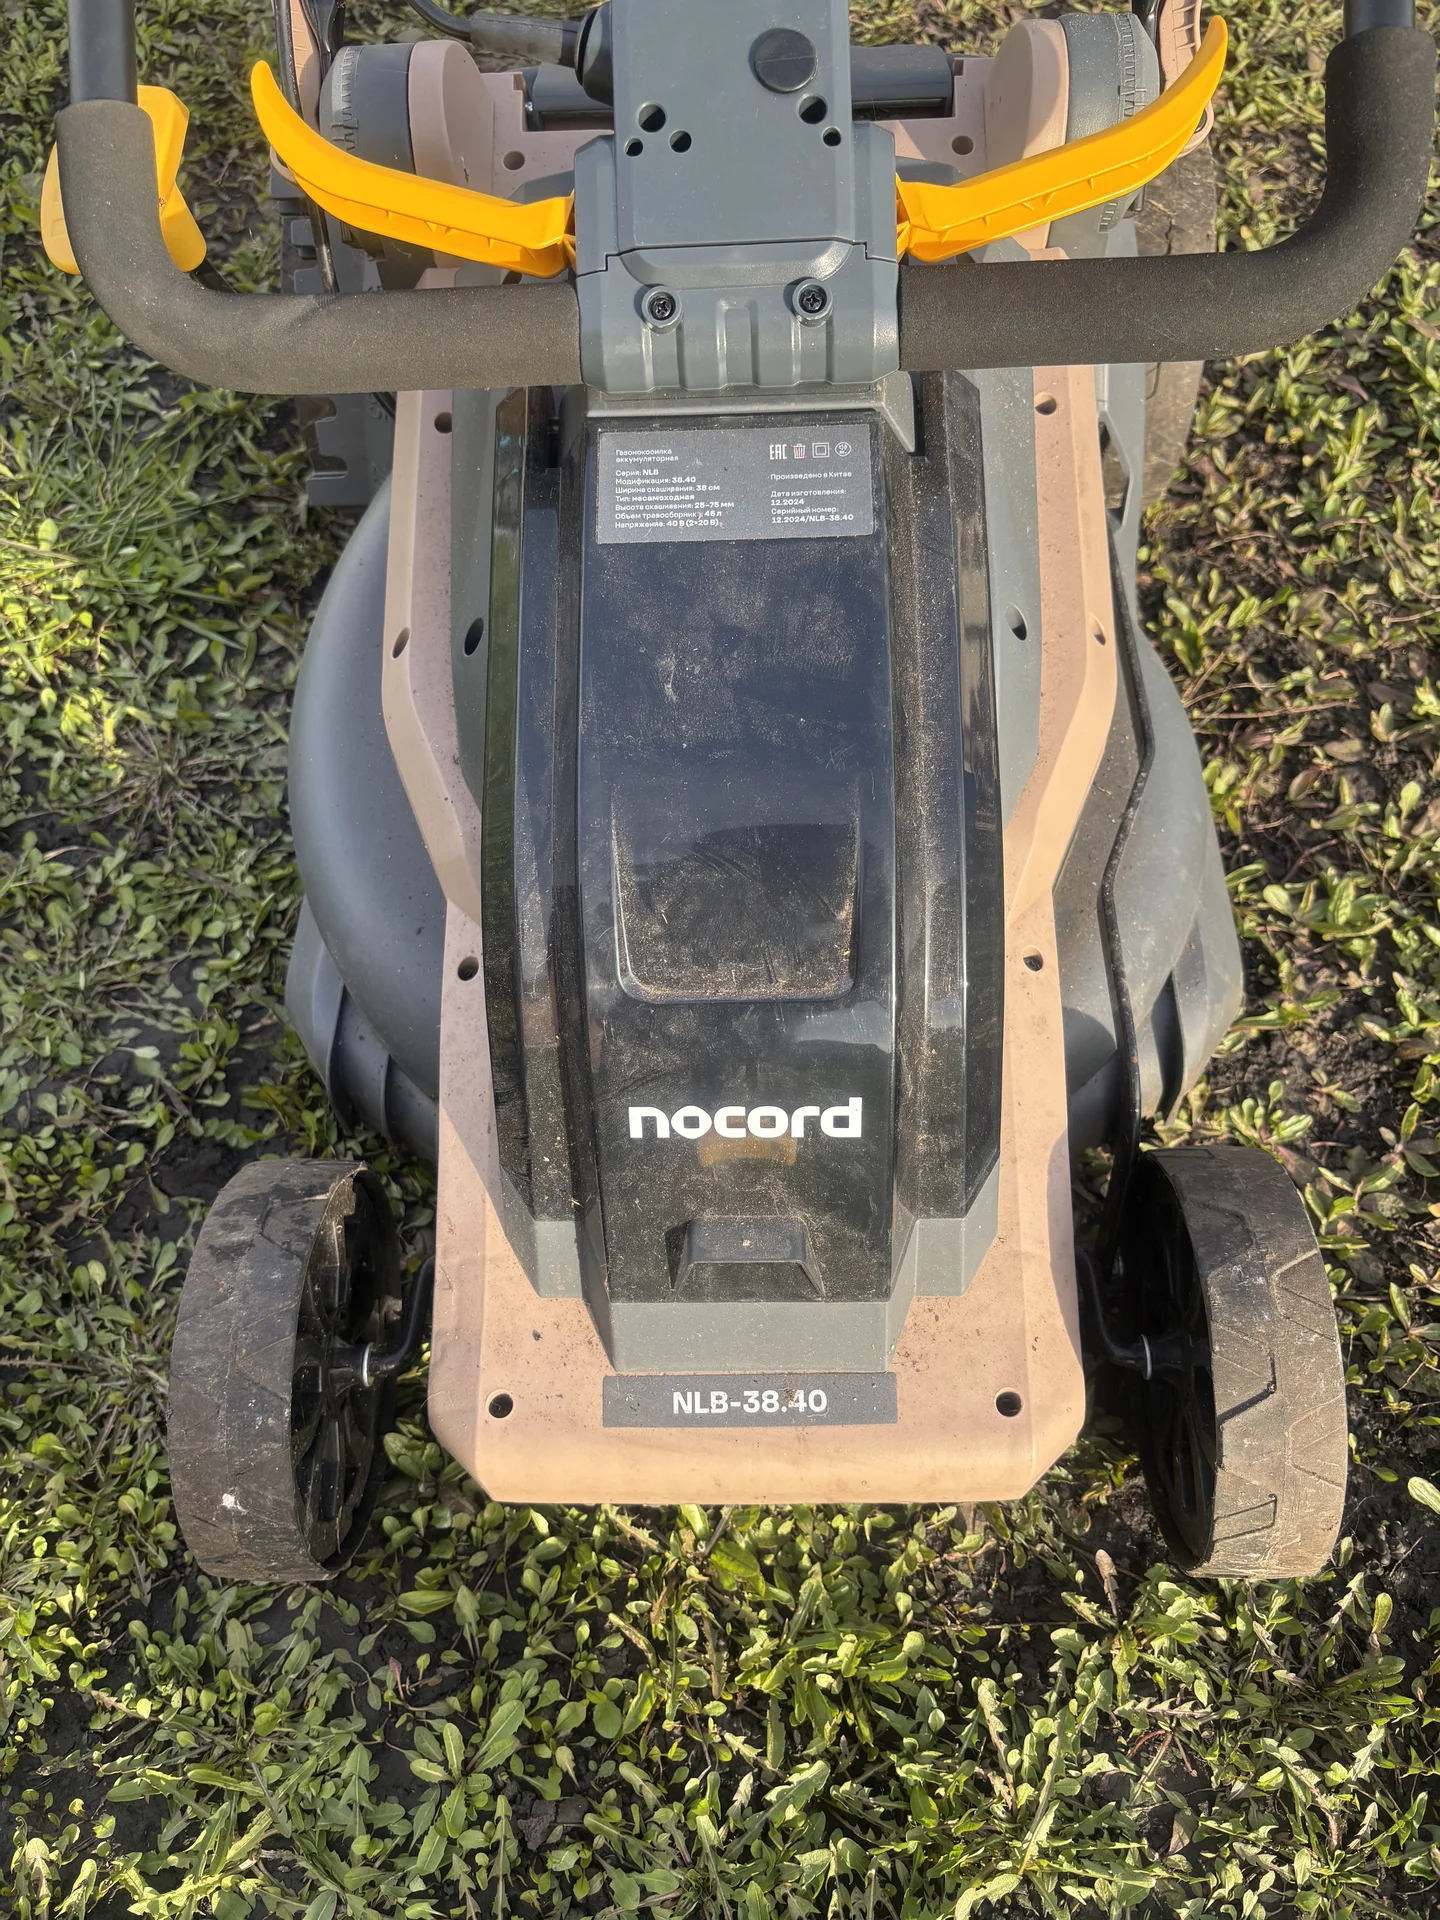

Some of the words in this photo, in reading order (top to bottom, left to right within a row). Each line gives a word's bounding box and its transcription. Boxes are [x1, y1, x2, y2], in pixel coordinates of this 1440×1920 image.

[771, 473, 822, 481] Произведено
[771, 507, 810, 515] Серийный
[772, 514, 854, 523] 12.2024/NLB-38.40
[628, 1097, 862, 1139] nocord
[672, 1389, 828, 1414] NLB-38.40
